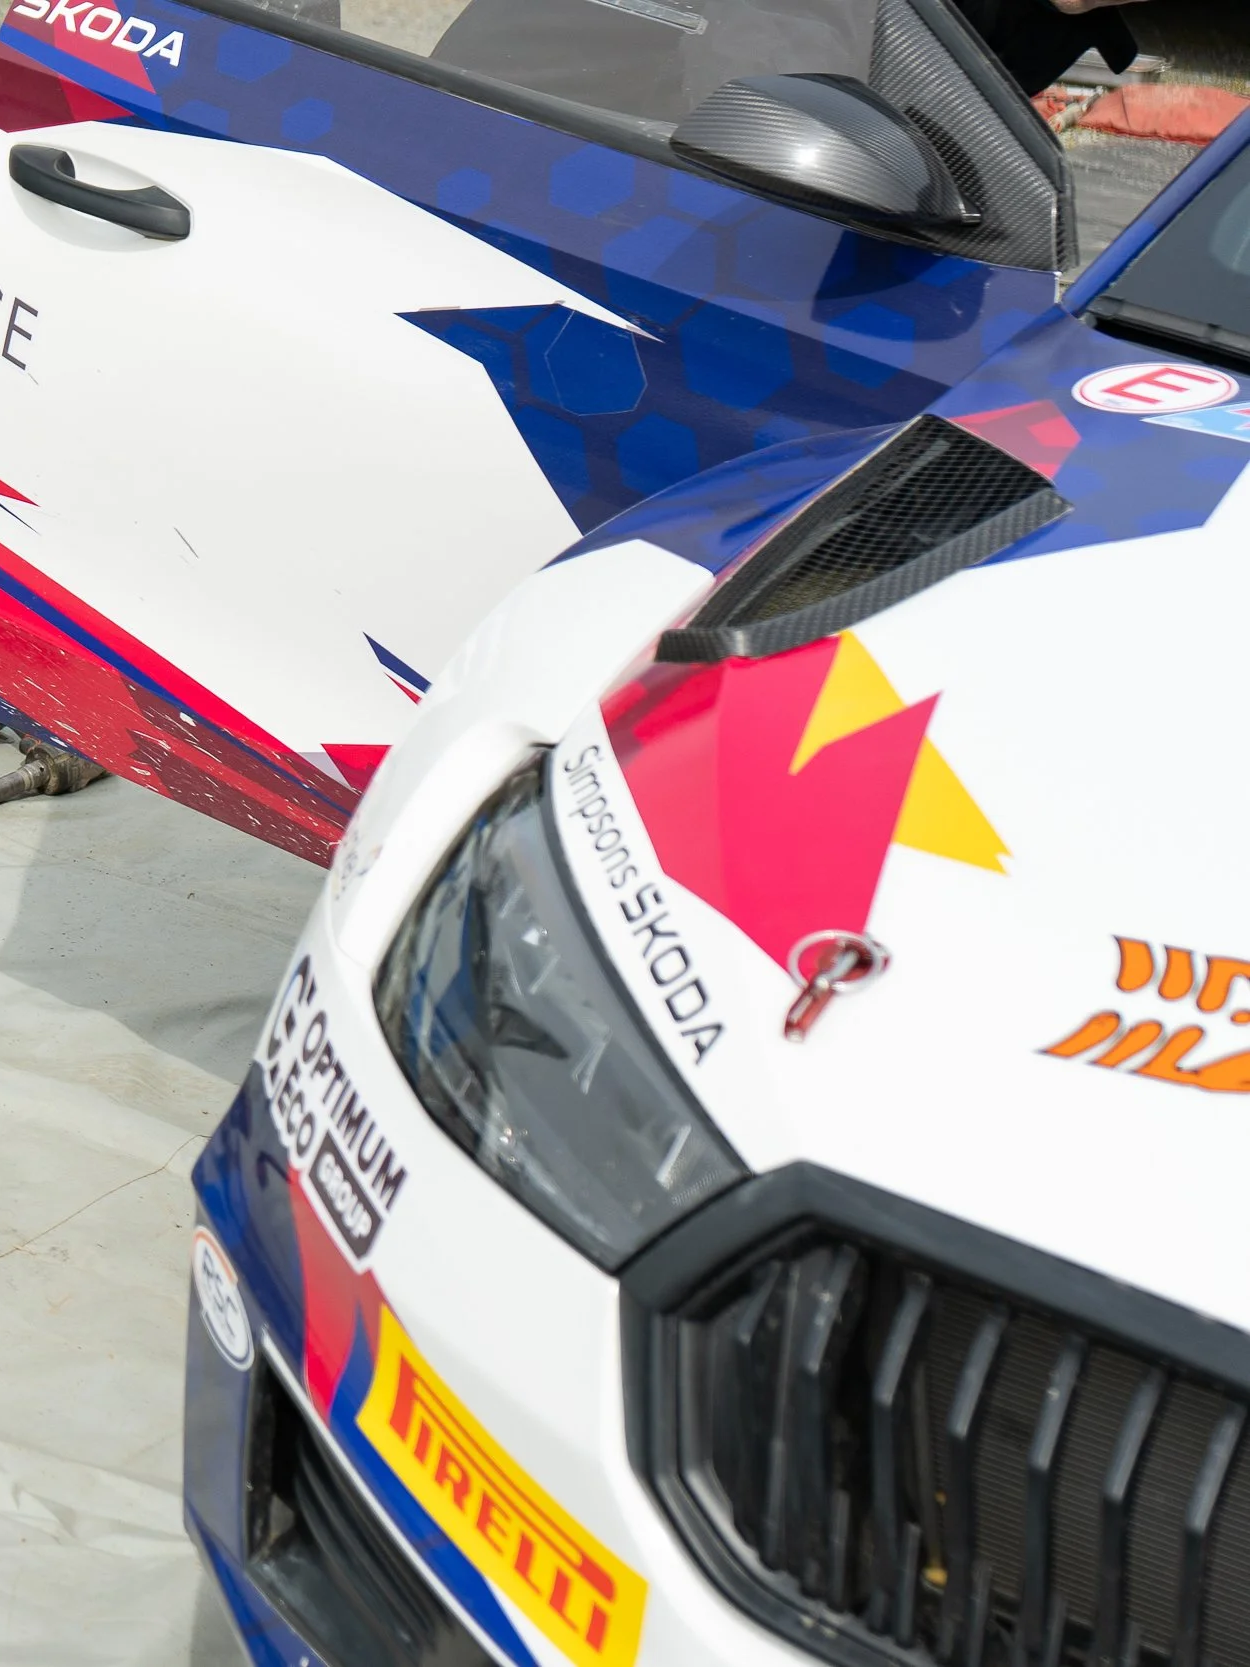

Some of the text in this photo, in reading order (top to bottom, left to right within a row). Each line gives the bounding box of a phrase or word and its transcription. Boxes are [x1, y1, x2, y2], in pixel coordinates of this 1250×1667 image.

[1100, 367, 1219, 405] E
[564, 744, 638, 890] Simpsons
[302, 1010, 409, 1211] OPTIMUM
[316, 1151, 373, 1239] GROUP
[389, 1352, 617, 1655] PIRELLI
